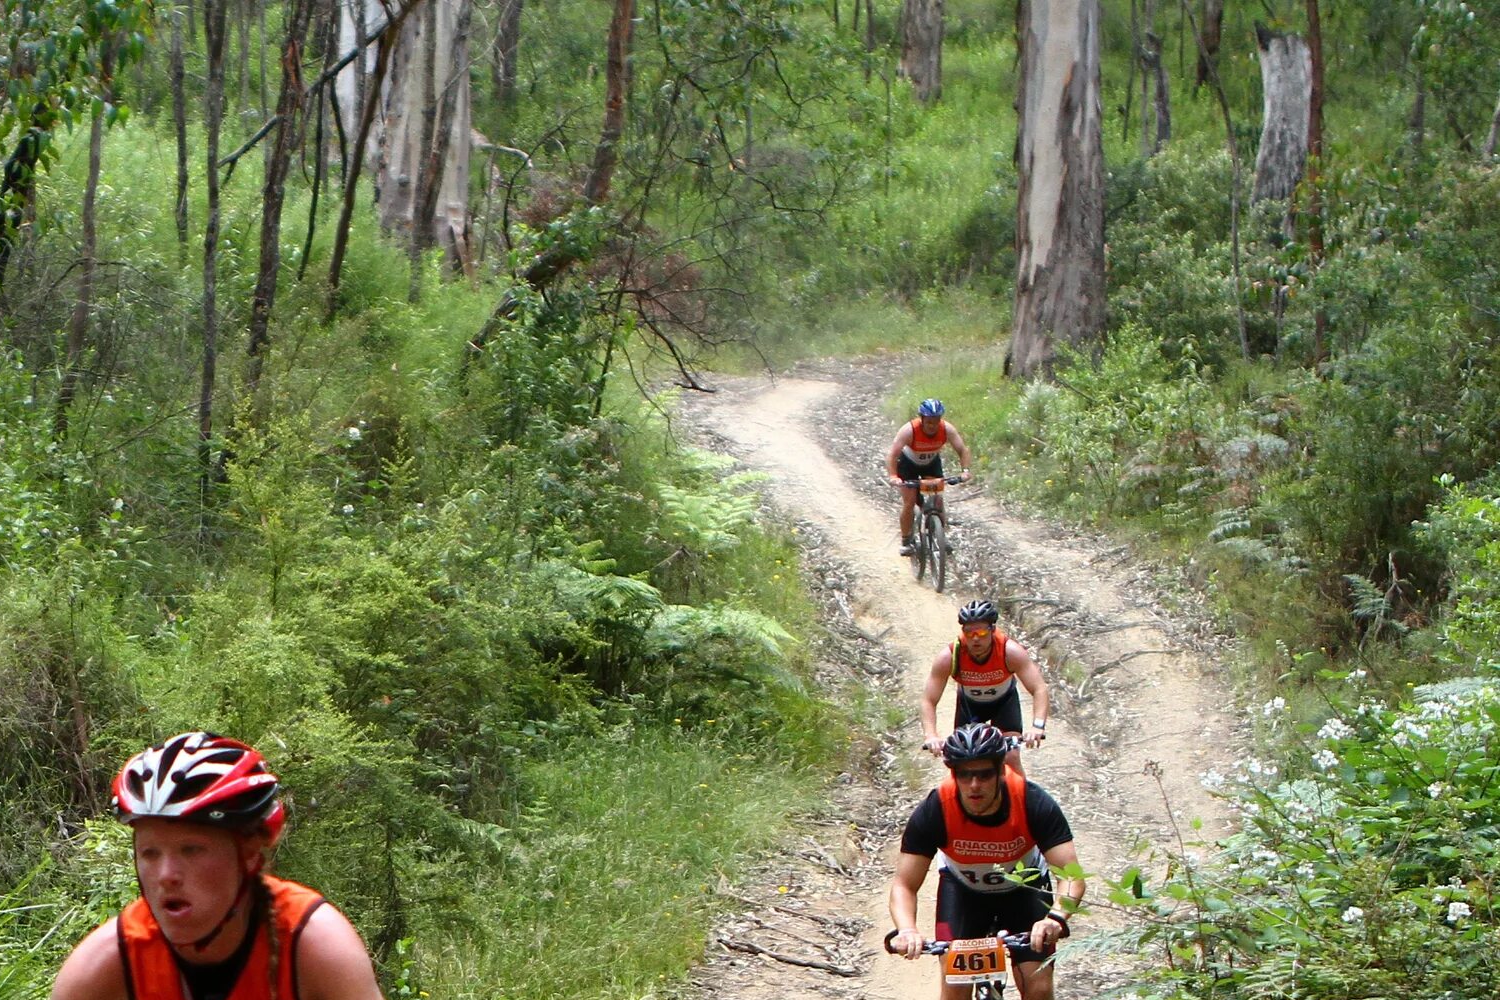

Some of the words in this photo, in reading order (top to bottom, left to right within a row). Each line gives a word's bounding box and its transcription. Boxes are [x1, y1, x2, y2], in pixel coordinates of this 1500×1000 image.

[954, 836, 1025, 851] ANACONDA
[959, 870, 1006, 886] 46
[953, 951, 997, 972] 461
